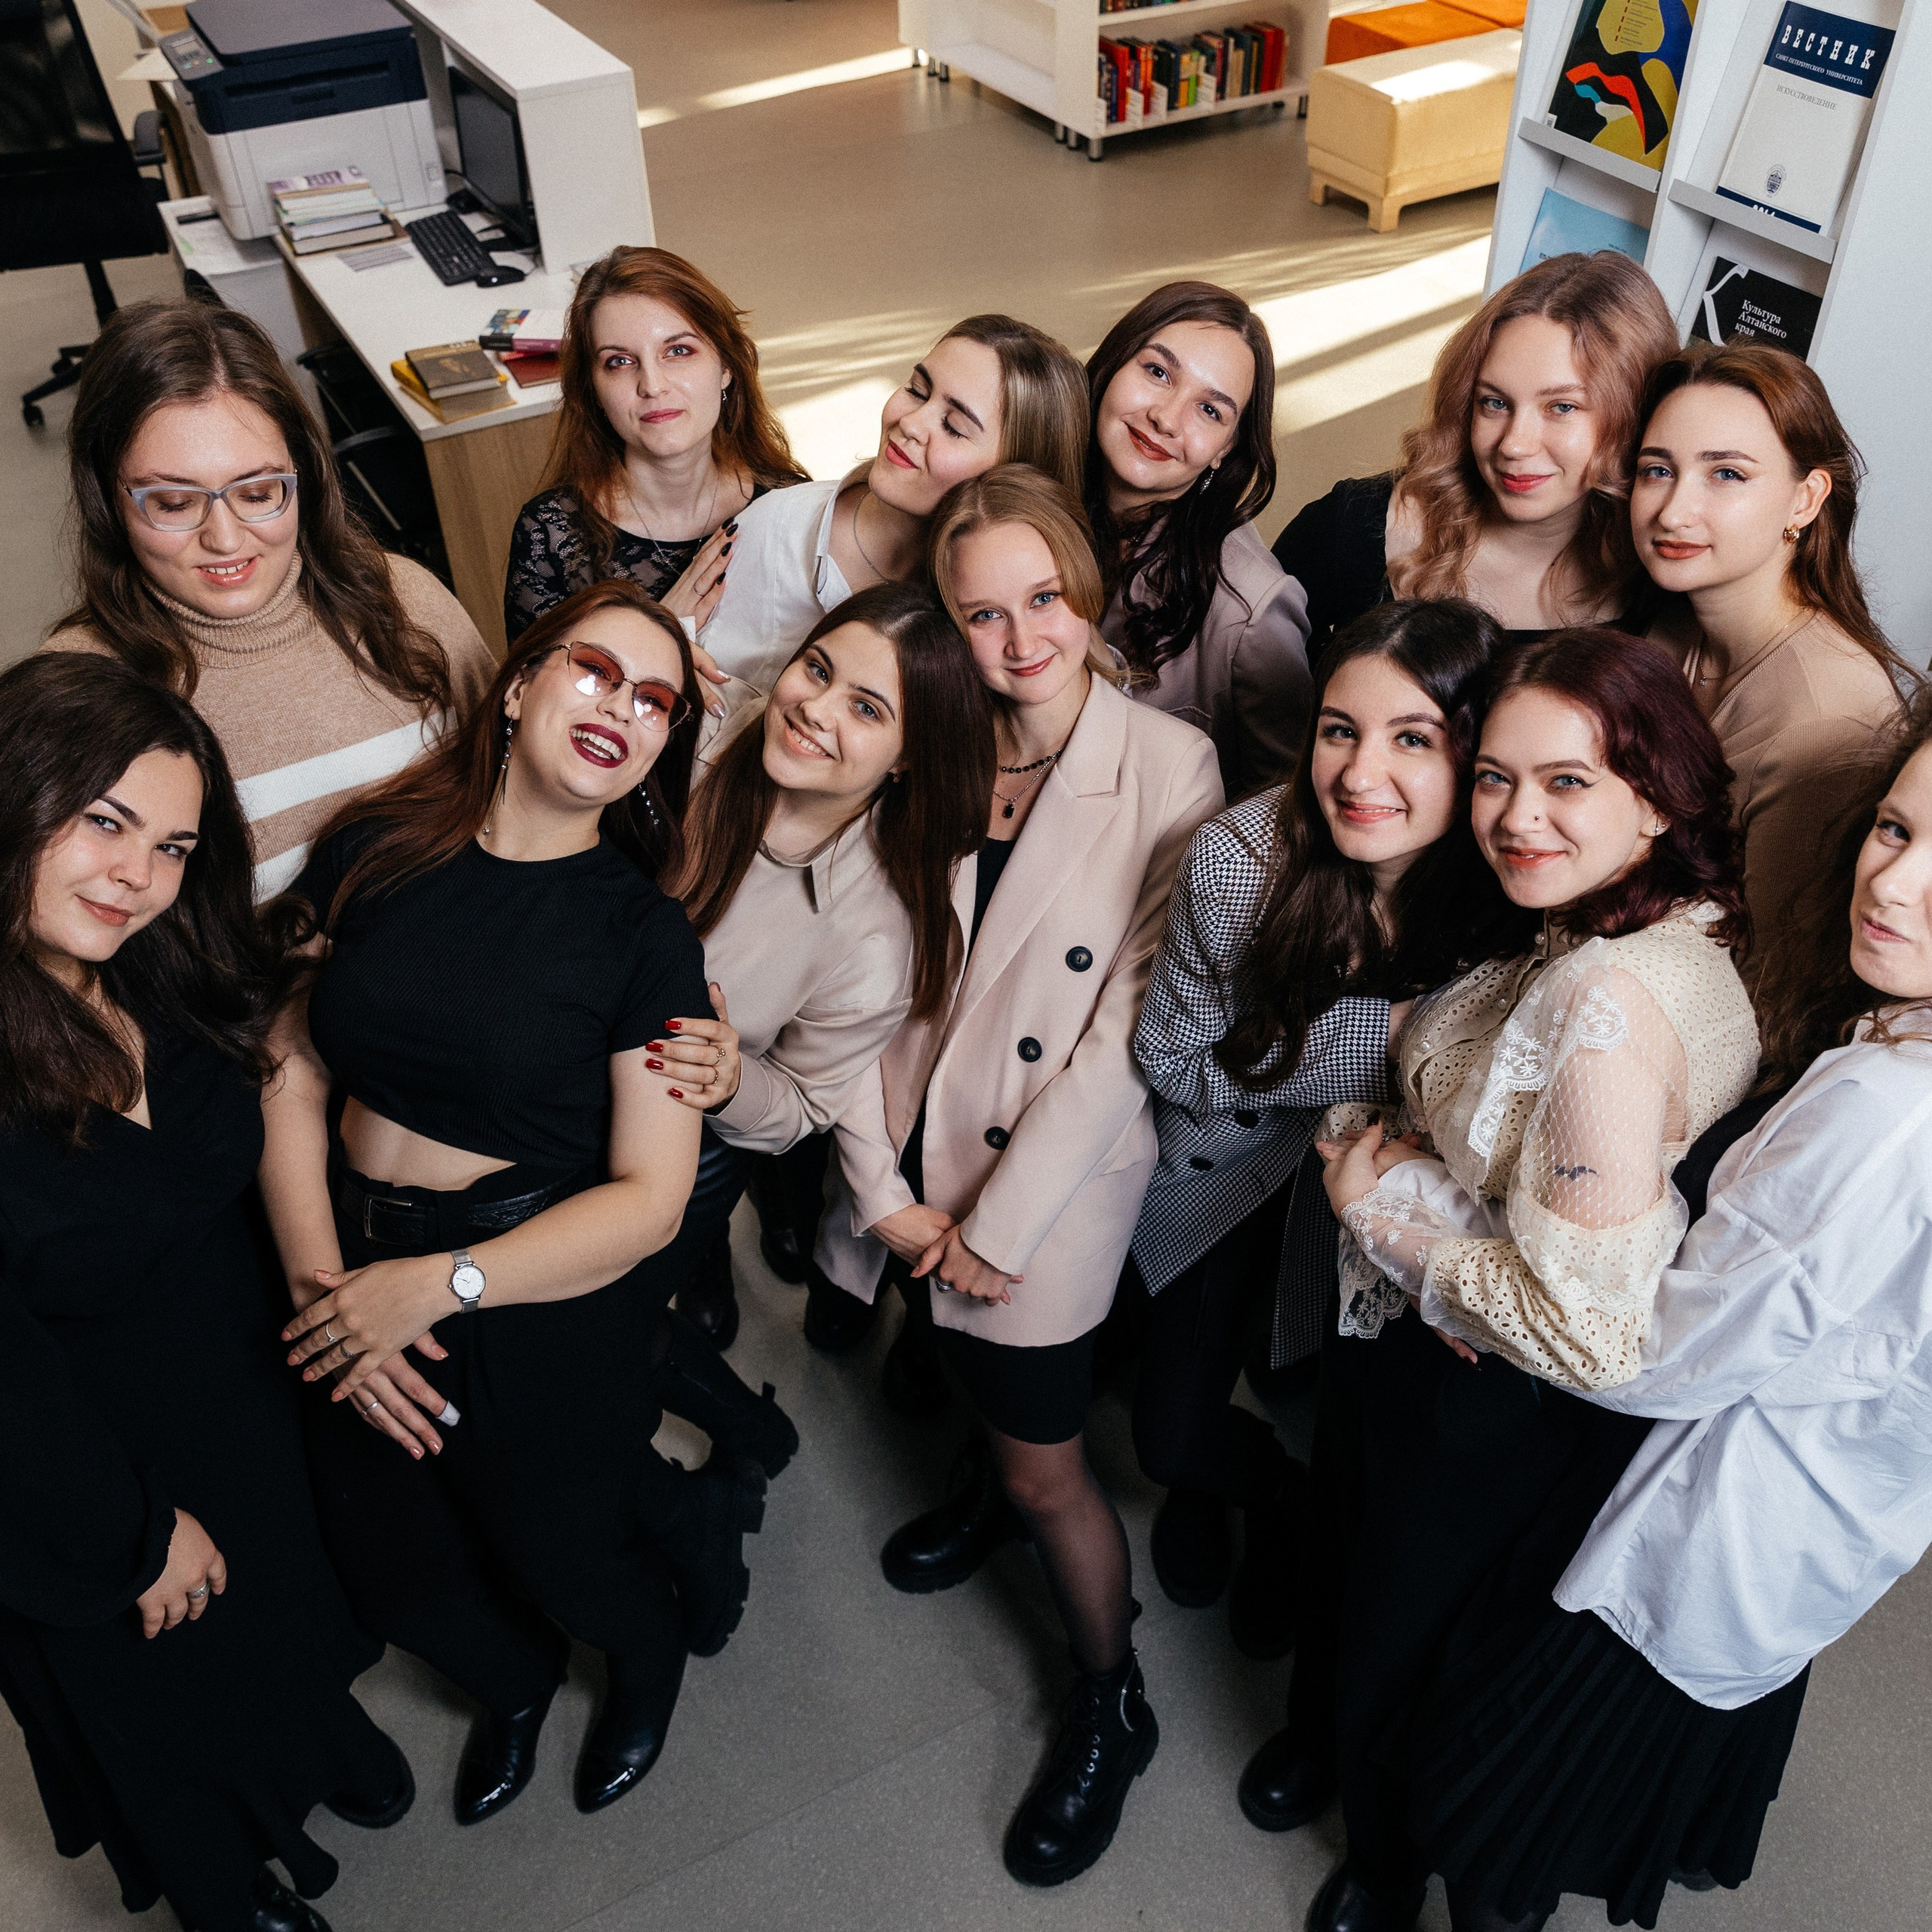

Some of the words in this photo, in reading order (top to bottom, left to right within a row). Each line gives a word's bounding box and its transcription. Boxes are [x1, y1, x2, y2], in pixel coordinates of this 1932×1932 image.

[1781, 24, 1875, 69] ВЕСТНИК
[1775, 53, 1825, 74] САНКТ-ПЕТЕРБУРГСКОГО
[1826, 69, 1863, 85] УНИВЕРСИТЕТА
[1776, 85, 1838, 110] ИСКУССТВОВЕДЕНИЕ
[1738, 311, 1787, 339] Алтайского
[1742, 300, 1781, 325] Культура
[1734, 322, 1755, 337] края
